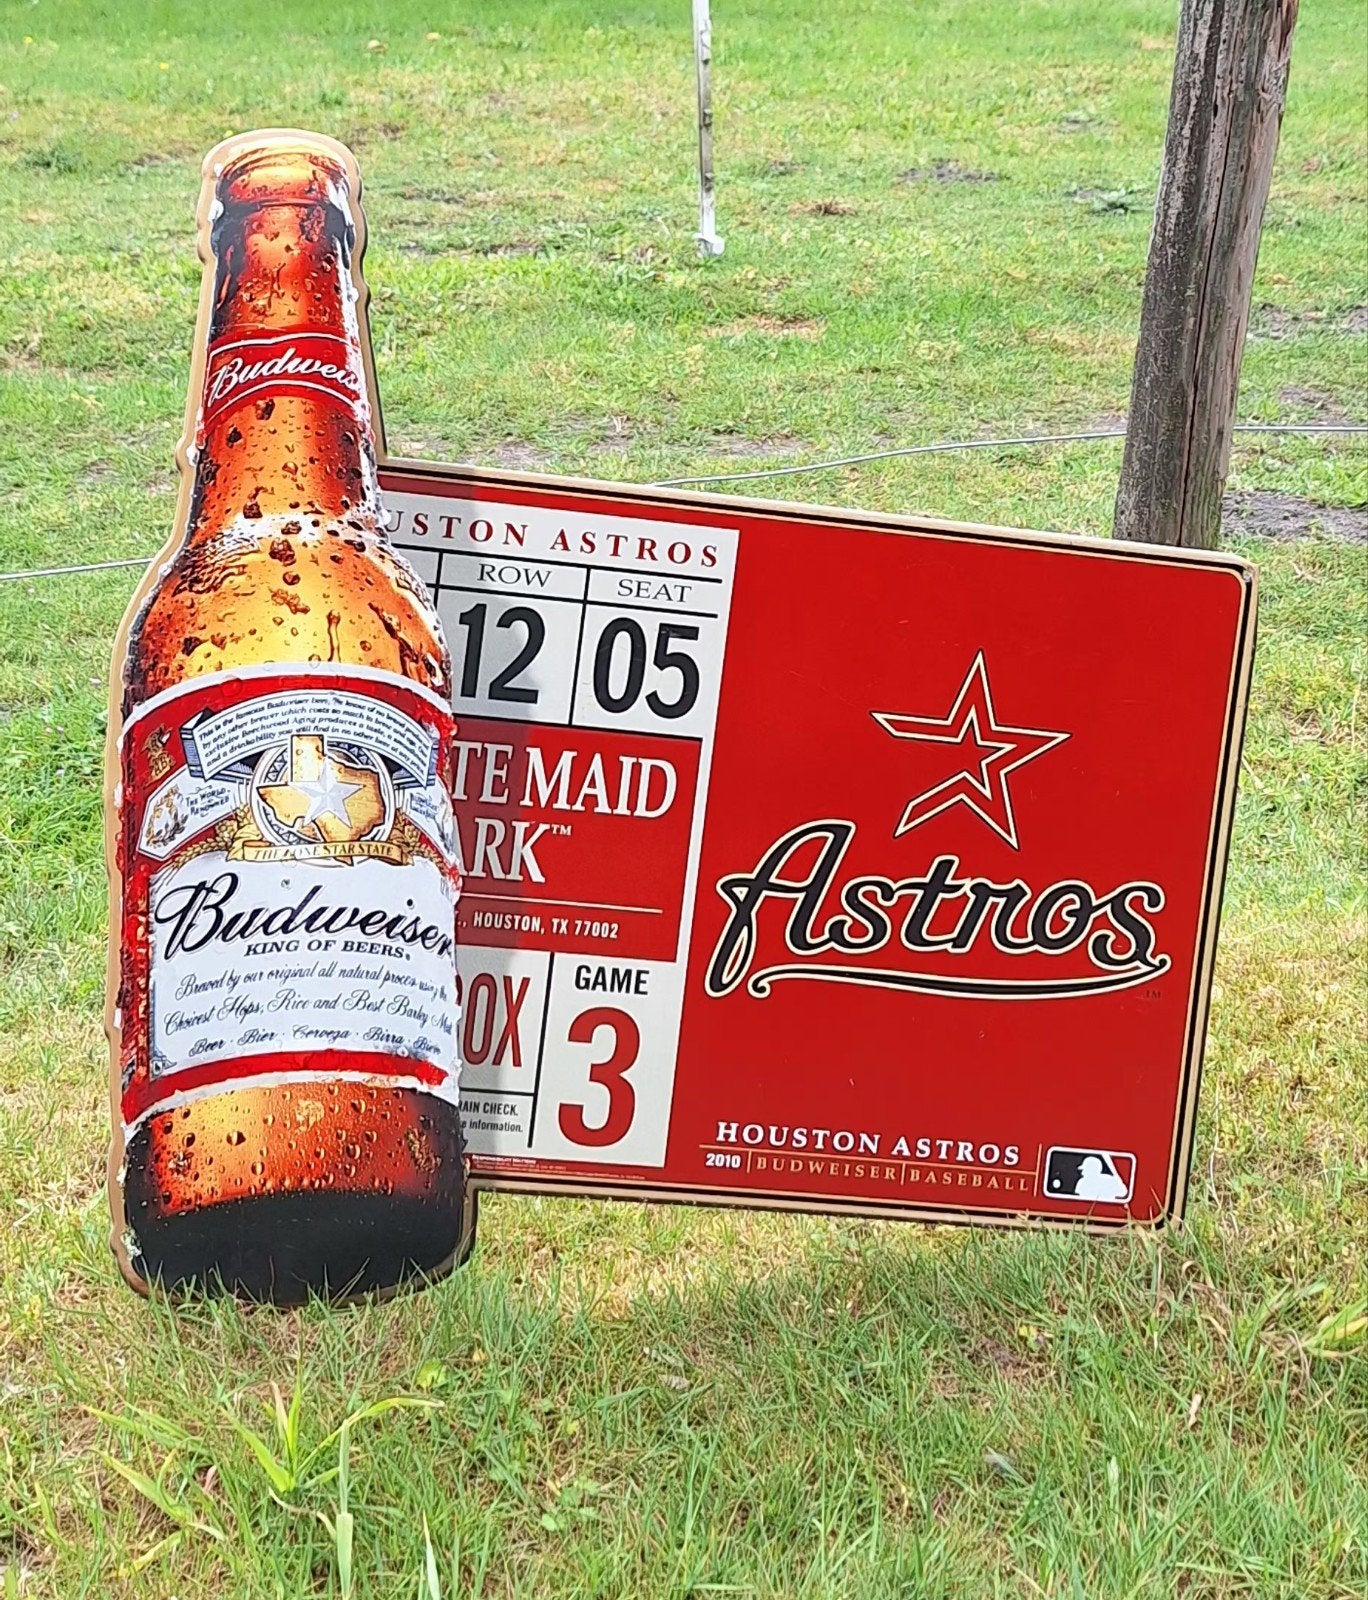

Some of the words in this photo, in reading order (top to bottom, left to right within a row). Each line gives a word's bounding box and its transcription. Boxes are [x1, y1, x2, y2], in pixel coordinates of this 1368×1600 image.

[549, 528, 718, 568] ASTROS
[477, 563, 552, 588] ROW
[617, 578, 692, 602] SEAT
[459, 603, 546, 705] 12
[593, 616, 701, 720] 05
[520, 747, 678, 819] MAID
[323, 845, 354, 855] STAR
[357, 845, 393, 856] STATE
[154, 872, 452, 961] Budweiser
[473, 911, 545, 934] HOUSTON,
[552, 918, 567, 934] TX
[574, 920, 619, 939] 77002
[703, 817, 1171, 999] Astros
[244, 940, 299, 957] KING
[307, 939, 336, 951] OF
[243, 971, 263, 984] our
[267, 961, 319, 986] original
[318, 961, 338, 978] all
[338, 963, 384, 980] natural
[575, 964, 650, 995] GAME
[267, 988, 310, 1012] Rice
[313, 992, 342, 1009] and
[342, 989, 385, 1011] Best
[455, 972, 530, 1067] OX
[188, 1038, 226, 1057] Beer
[558, 1007, 641, 1147] 3
[483, 1102, 518, 1116] CHECK.
[716, 1120, 881, 1156] HOUSTON
[891, 1135, 1020, 1166] ASTROS
[705, 1151, 741, 1171] 2010
[755, 1156, 897, 1181] BUDWEISER
[909, 1168, 1029, 1192] BASEBALL
